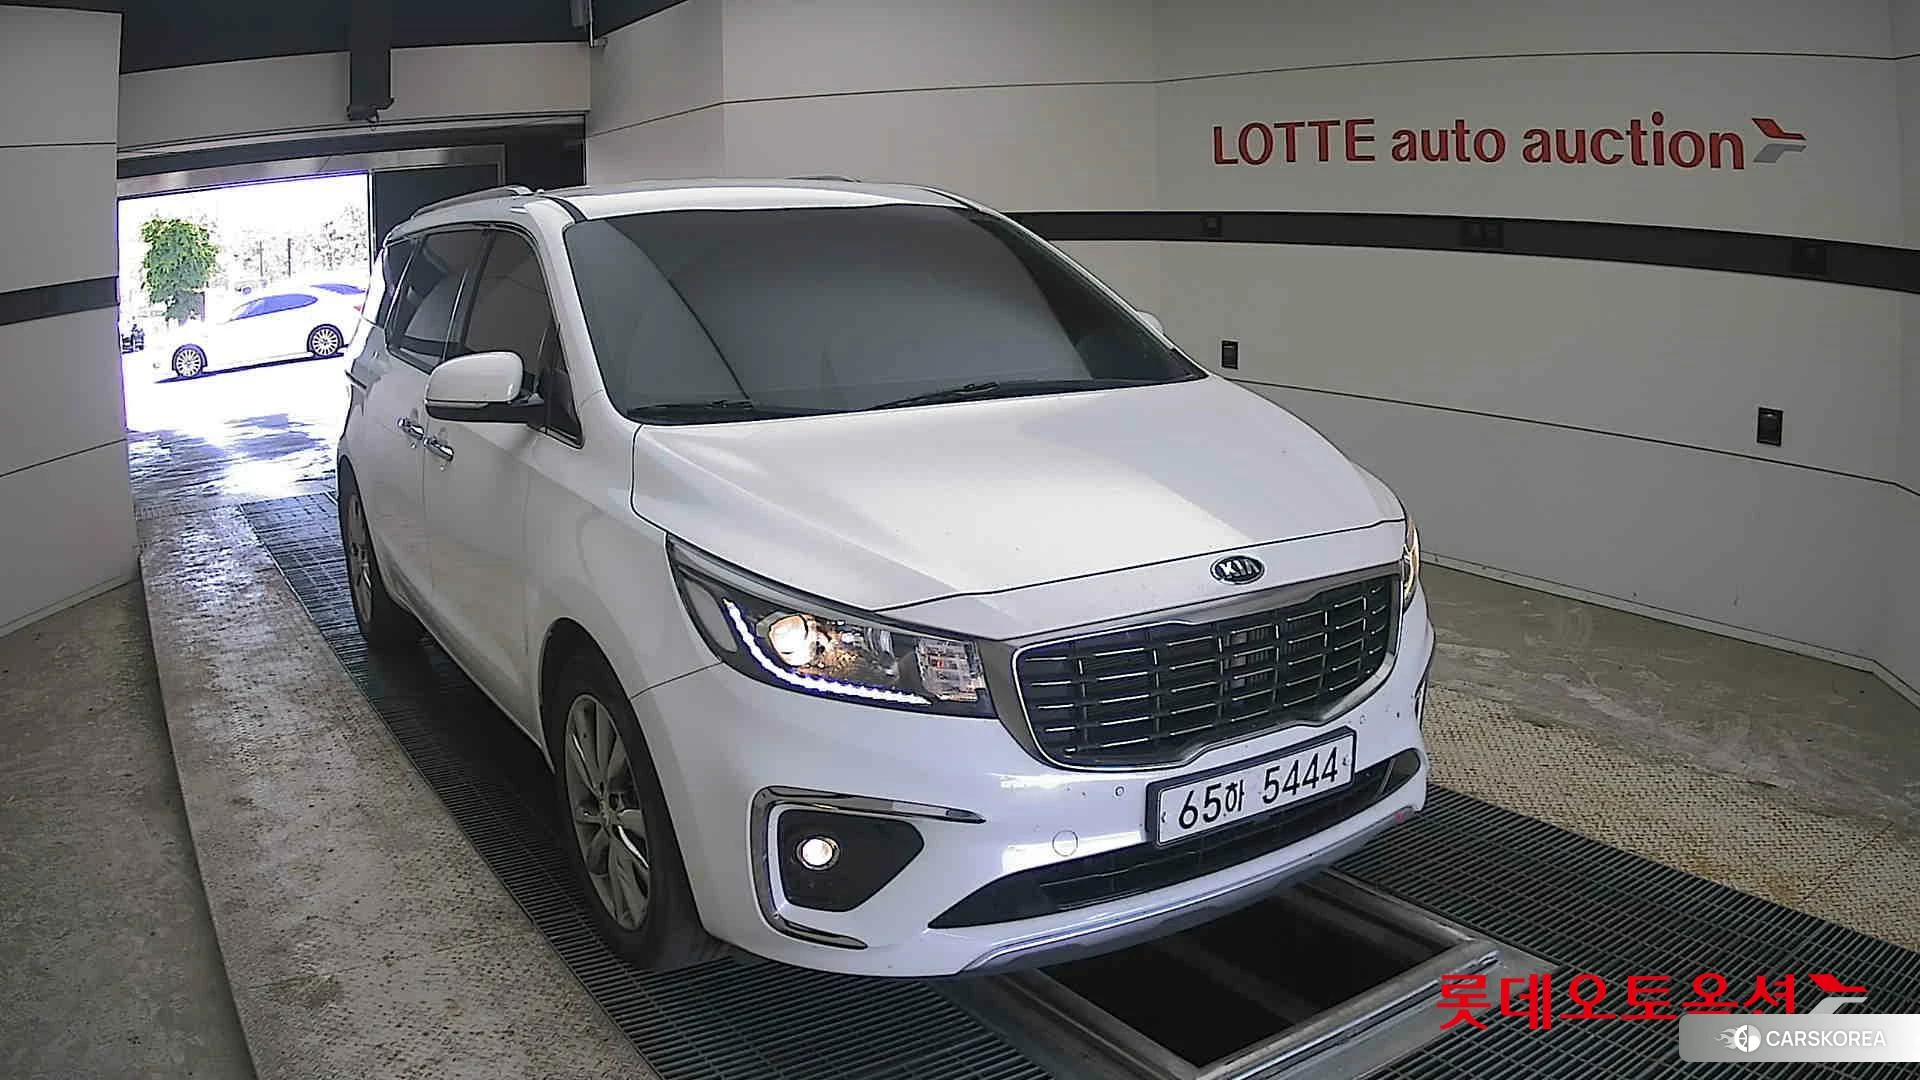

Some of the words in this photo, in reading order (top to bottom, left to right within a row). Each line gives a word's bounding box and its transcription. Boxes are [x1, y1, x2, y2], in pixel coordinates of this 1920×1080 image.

[1213, 118, 1376, 165] LOTTE
[1391, 119, 1506, 163] auto
[1522, 111, 1746, 170] auction
[1218, 559, 1260, 578] KIA
[1178, 779, 1244, 829] 65하
[1262, 747, 1338, 804] 5444
